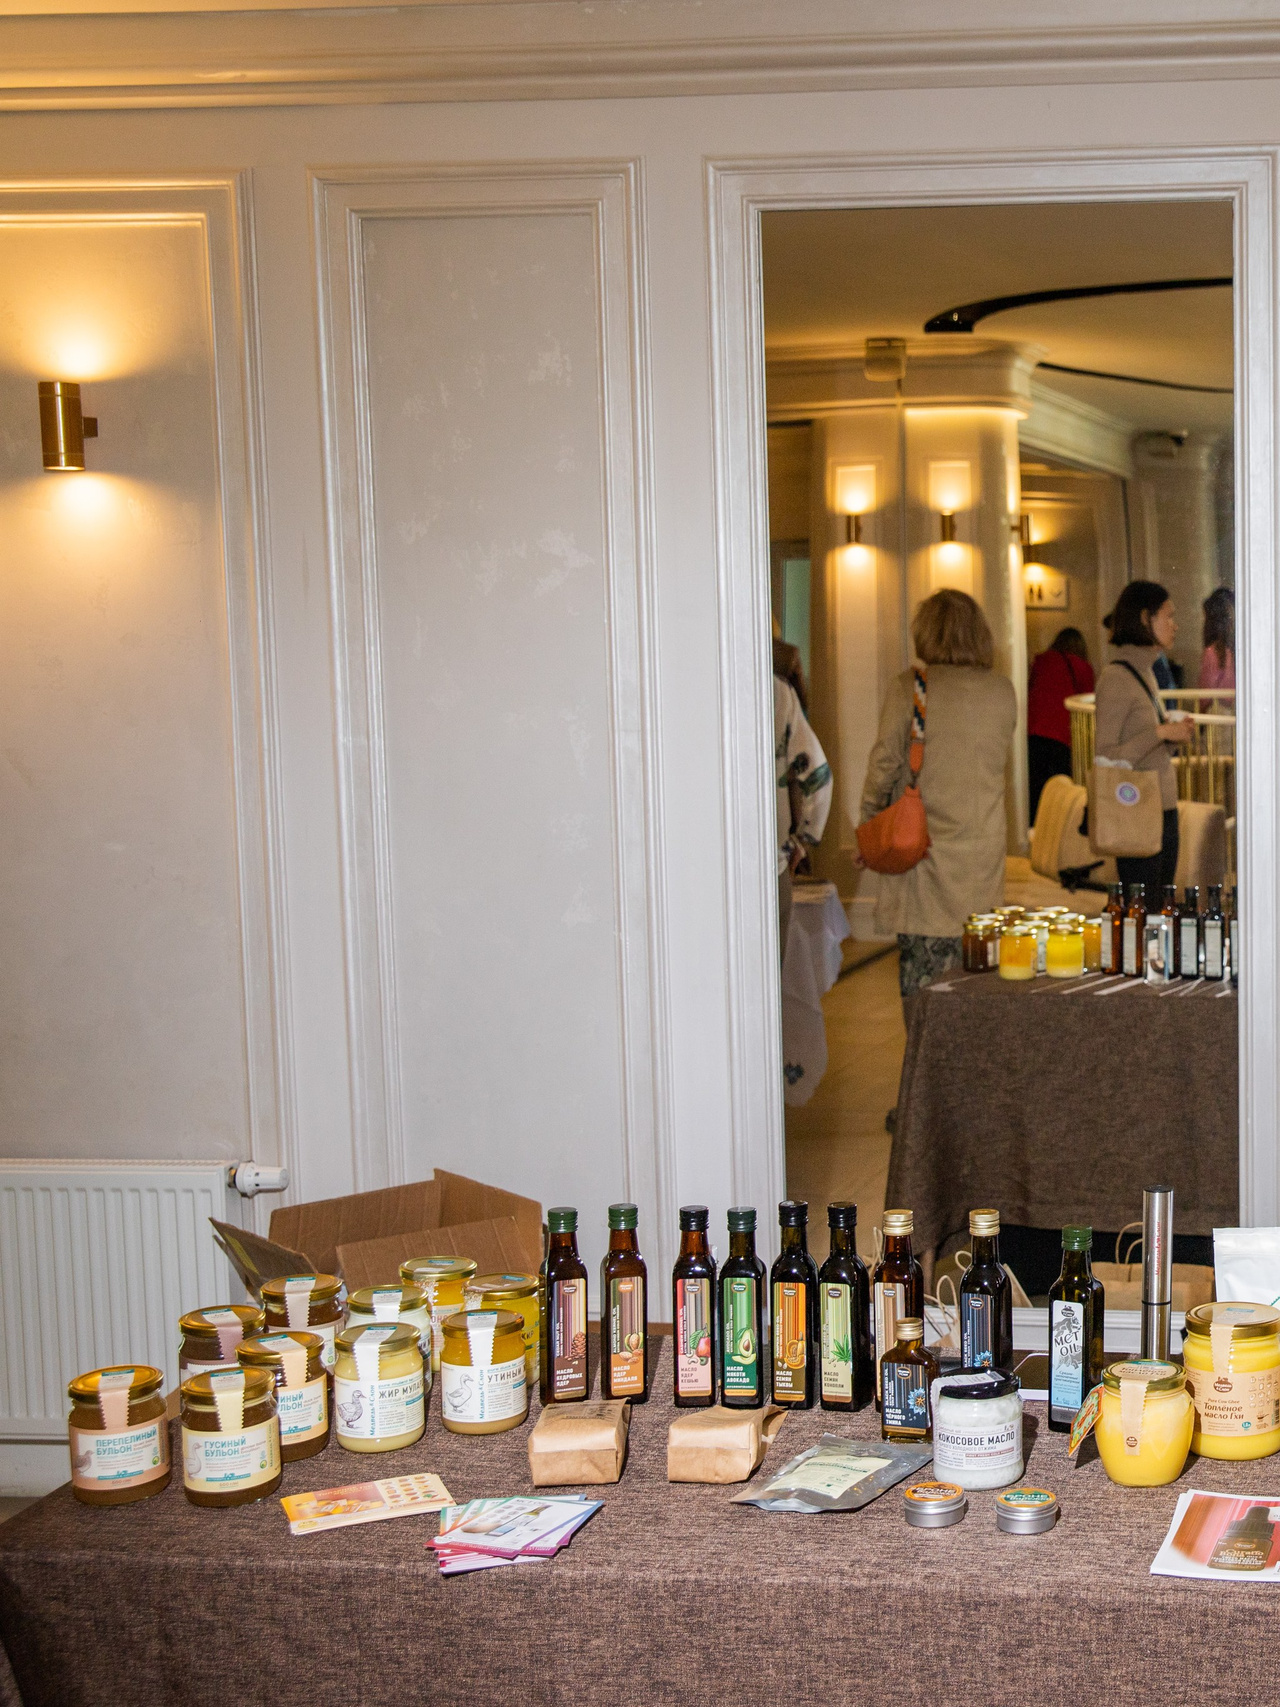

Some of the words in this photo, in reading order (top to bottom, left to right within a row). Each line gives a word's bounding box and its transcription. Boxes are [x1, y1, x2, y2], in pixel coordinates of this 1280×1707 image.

[1054, 1331, 1079, 1347] MCT
[1060, 1343, 1079, 1357] OIL
[487, 1367, 522, 1383] УТИНЫЙ
[613, 1375, 638, 1383] МИНДАЛЯ
[280, 1391, 304, 1403] ИНЫЙ
[379, 1389, 400, 1399] ЖИР
[278, 1401, 303, 1411] ЛЬОН
[1204, 1402, 1243, 1412] Топлёное
[1204, 1412, 1228, 1420] масло
[1230, 1412, 1244, 1420] Гхи
[96, 1427, 157, 1447] ПЕРЕПЕЛИНЫЙ
[204, 1436, 246, 1449] ГУСИНЫЙ
[939, 1431, 987, 1446] КОКОСОВОЕ
[987, 1431, 1015, 1445] МАСЛО
[96, 1445, 132, 1455] БУЛЬОН
[205, 1449, 240, 1457] БУЛЬОН
